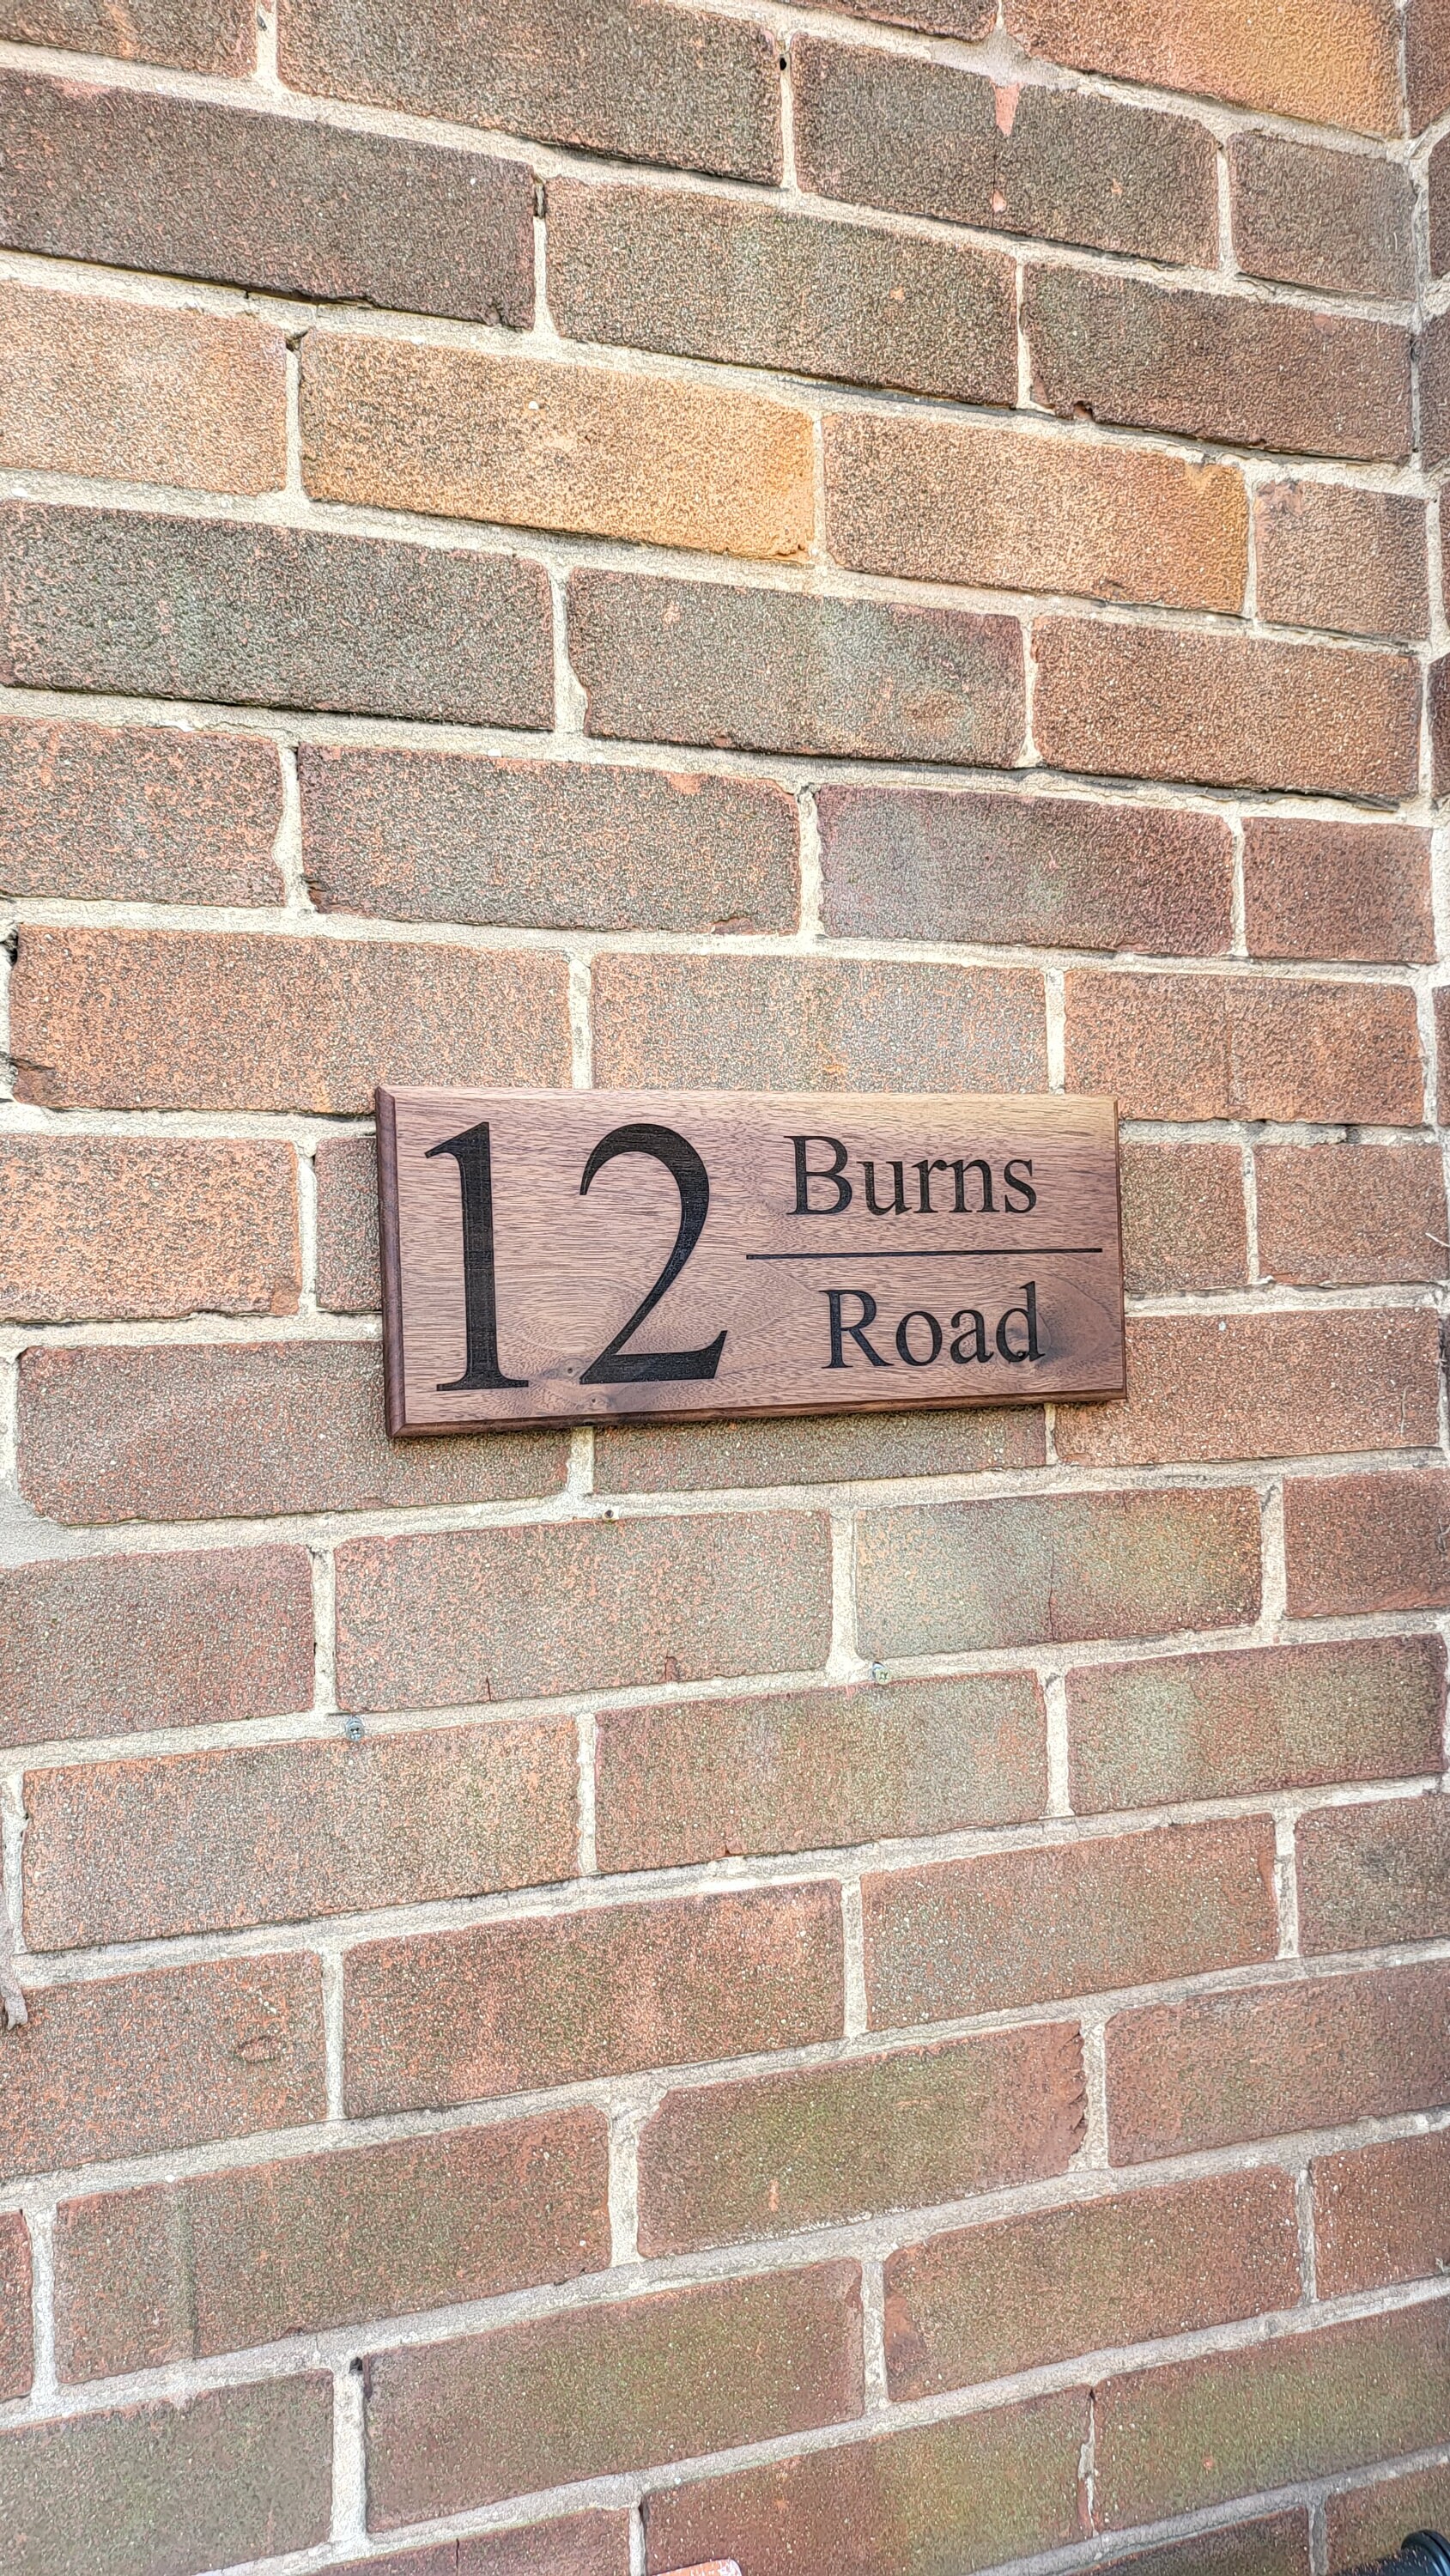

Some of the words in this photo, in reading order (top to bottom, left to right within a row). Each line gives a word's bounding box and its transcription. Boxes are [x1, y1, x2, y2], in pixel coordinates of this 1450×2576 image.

[783, 1135, 1038, 1216] Burns
[424, 1121, 728, 1392] 12
[818, 1280, 1047, 1370] Road
